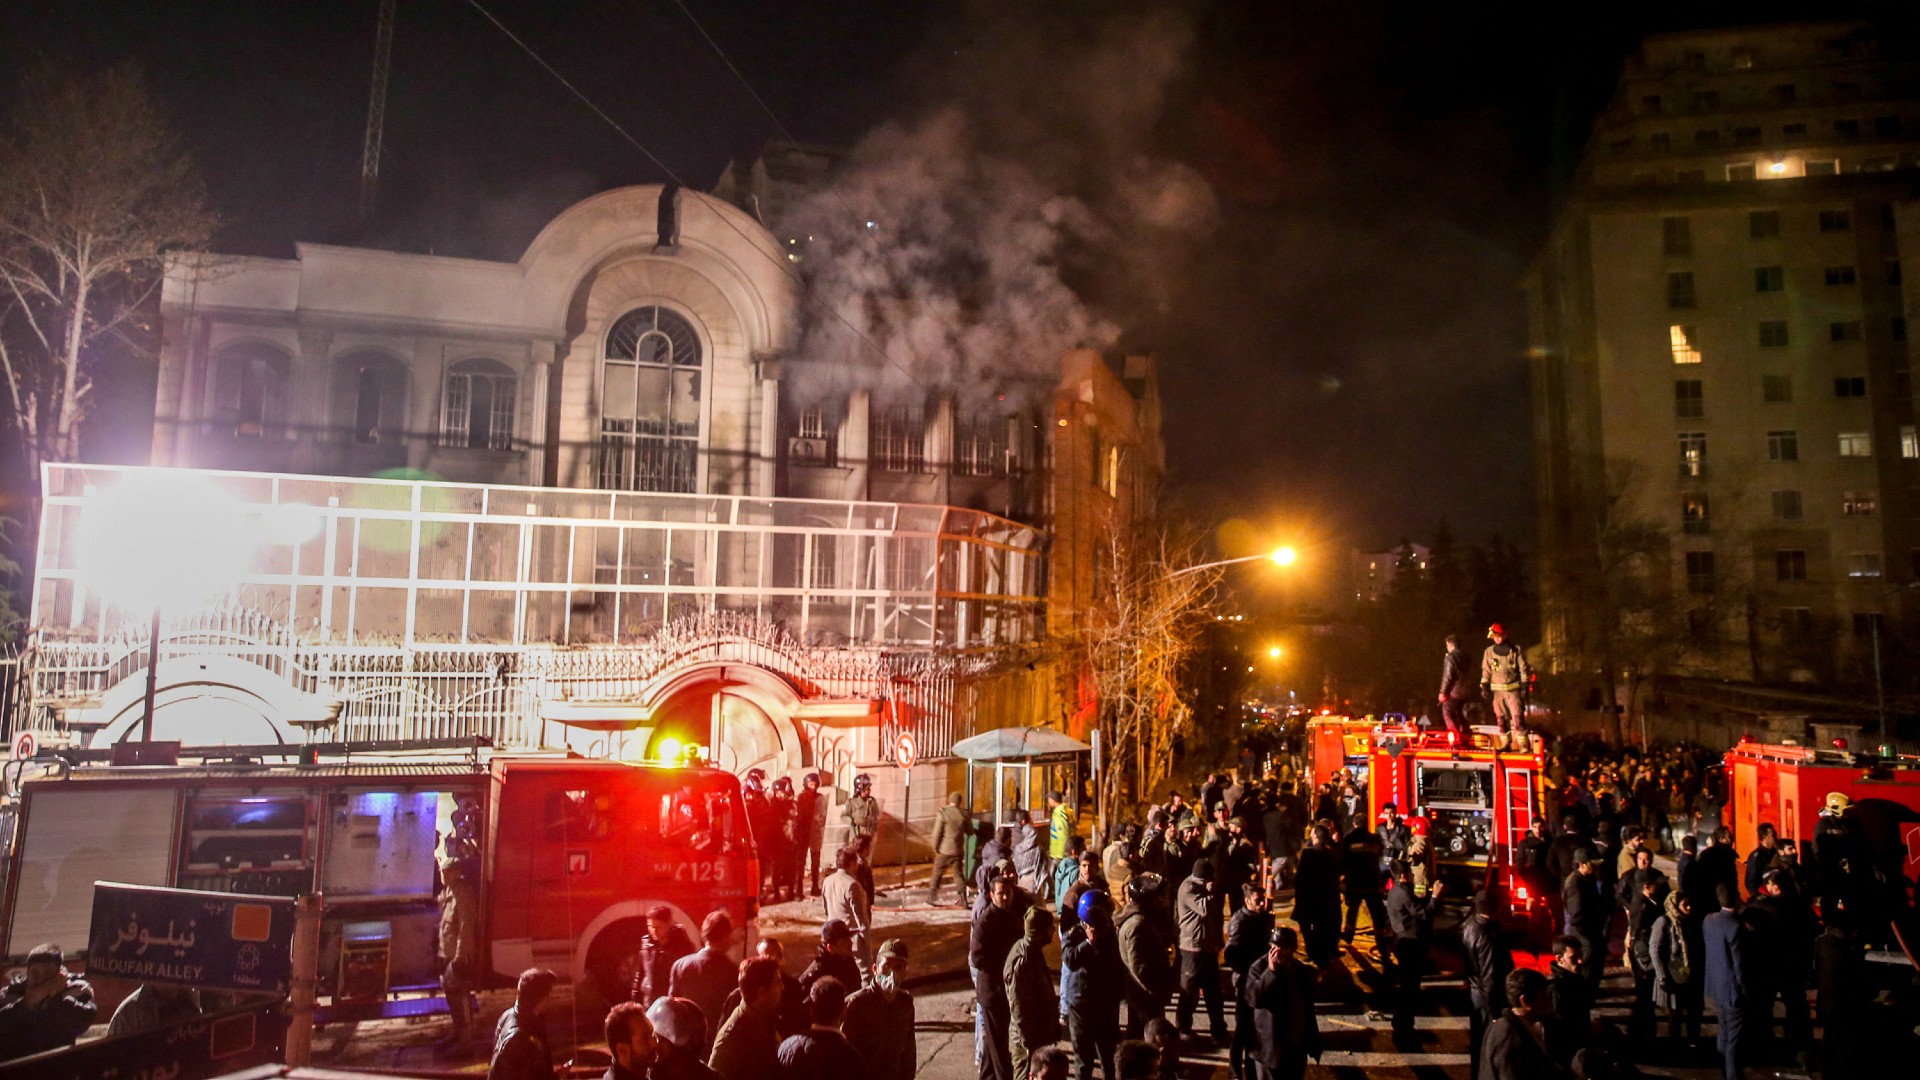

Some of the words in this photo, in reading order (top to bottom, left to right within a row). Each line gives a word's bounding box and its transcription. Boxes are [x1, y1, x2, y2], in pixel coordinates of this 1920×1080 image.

[690, 861, 725, 881] 125
[90, 957, 154, 977] NILOUFAR
[156, 963, 203, 980] ALLEY
